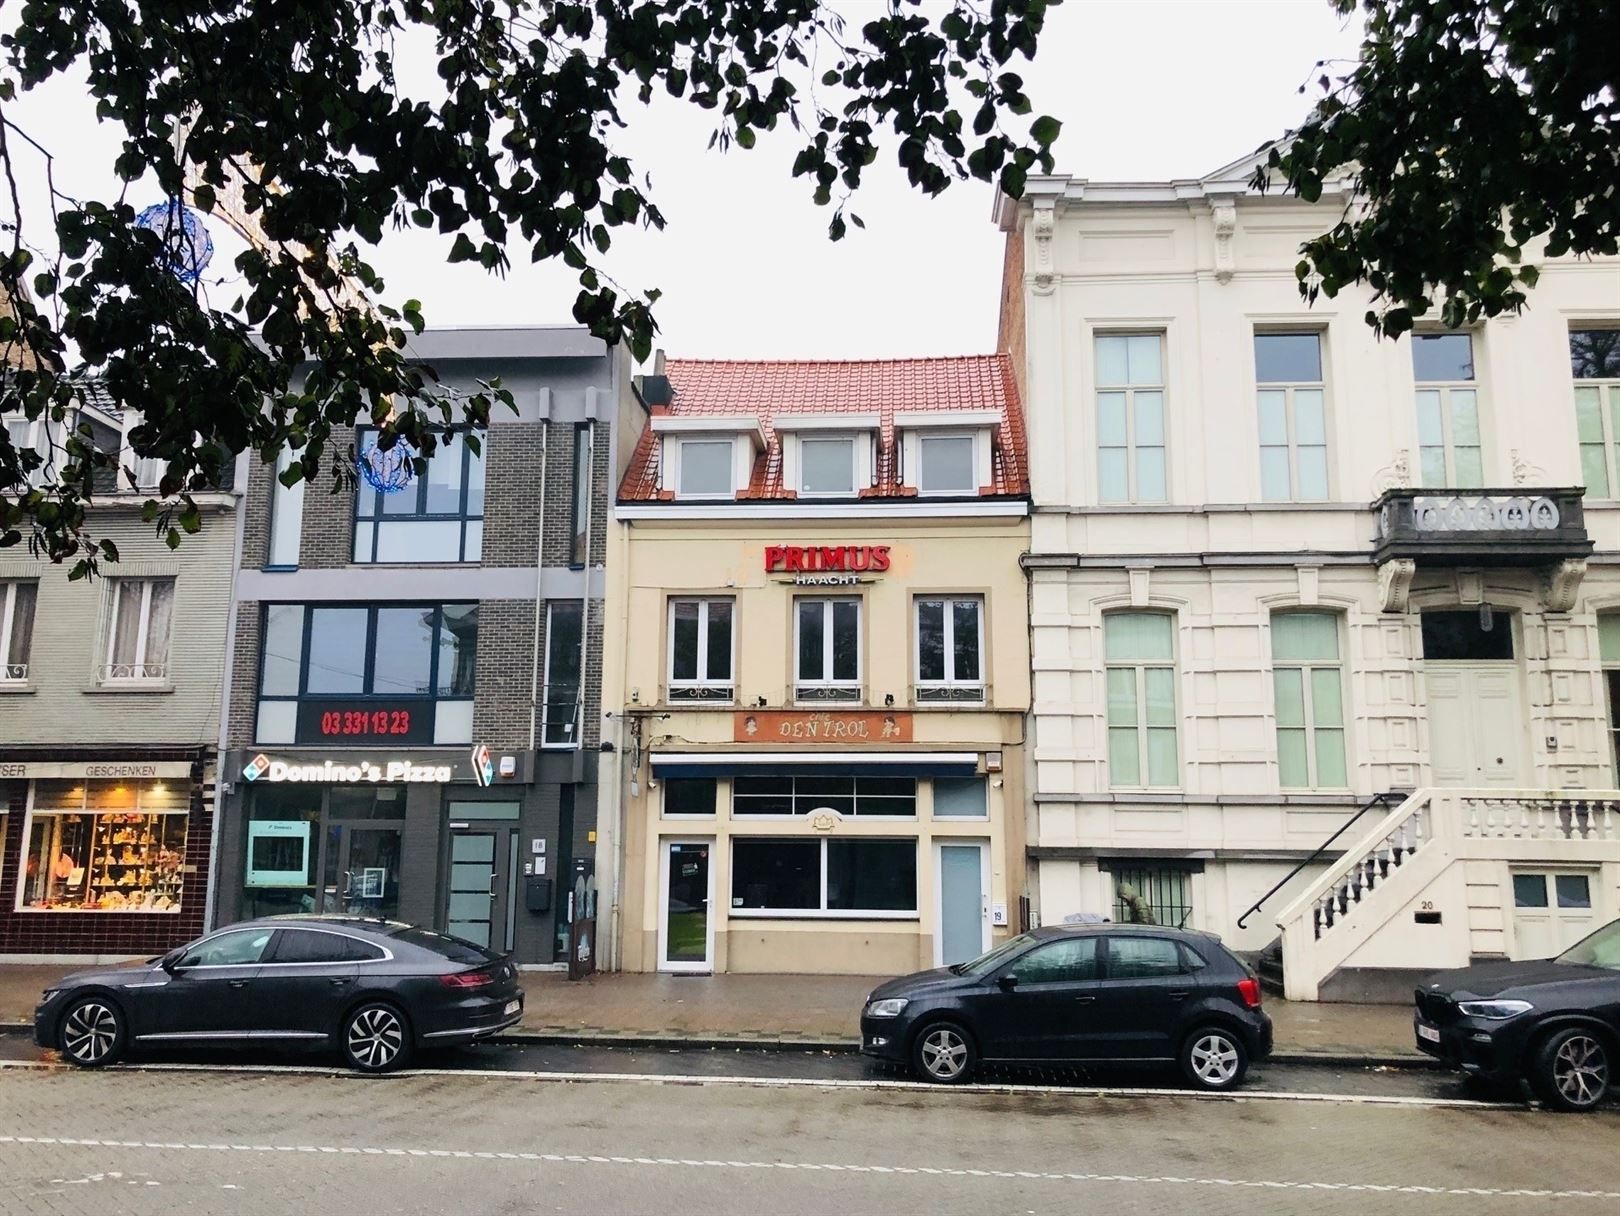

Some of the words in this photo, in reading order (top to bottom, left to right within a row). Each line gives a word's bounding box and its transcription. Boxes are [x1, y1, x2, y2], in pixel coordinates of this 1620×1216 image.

[765, 546, 890, 572] PRIMUS
[796, 575, 859, 585] HAACHT
[321, 711, 341, 735] 03
[342, 711, 369, 735] 331
[371, 711, 389, 734] 13
[390, 711, 410, 734] 23
[779, 721, 820, 737] DEN
[0, 764, 26, 776] SER
[86, 765, 156, 777] GESCHENKEN
[268, 760, 383, 782] Domino's
[386, 760, 451, 782] Pizza
[1421, 900, 1433, 910] 20
[994, 911, 1002, 921] 19
